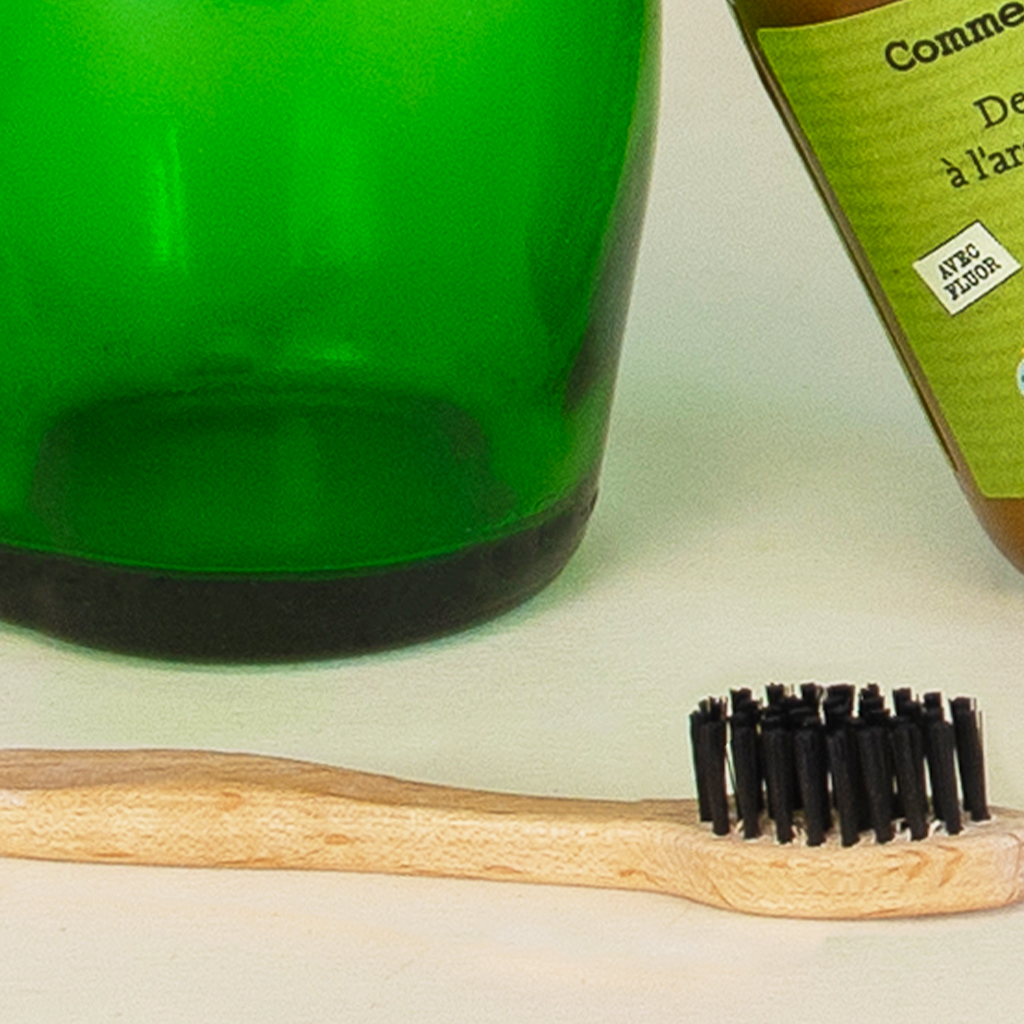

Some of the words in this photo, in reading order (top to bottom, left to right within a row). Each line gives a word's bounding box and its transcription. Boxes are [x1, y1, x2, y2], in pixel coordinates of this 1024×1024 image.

[941, 157, 968, 189] à
[938, 243, 980, 280] AVEC
[944, 257, 1002, 300] FLUOR
